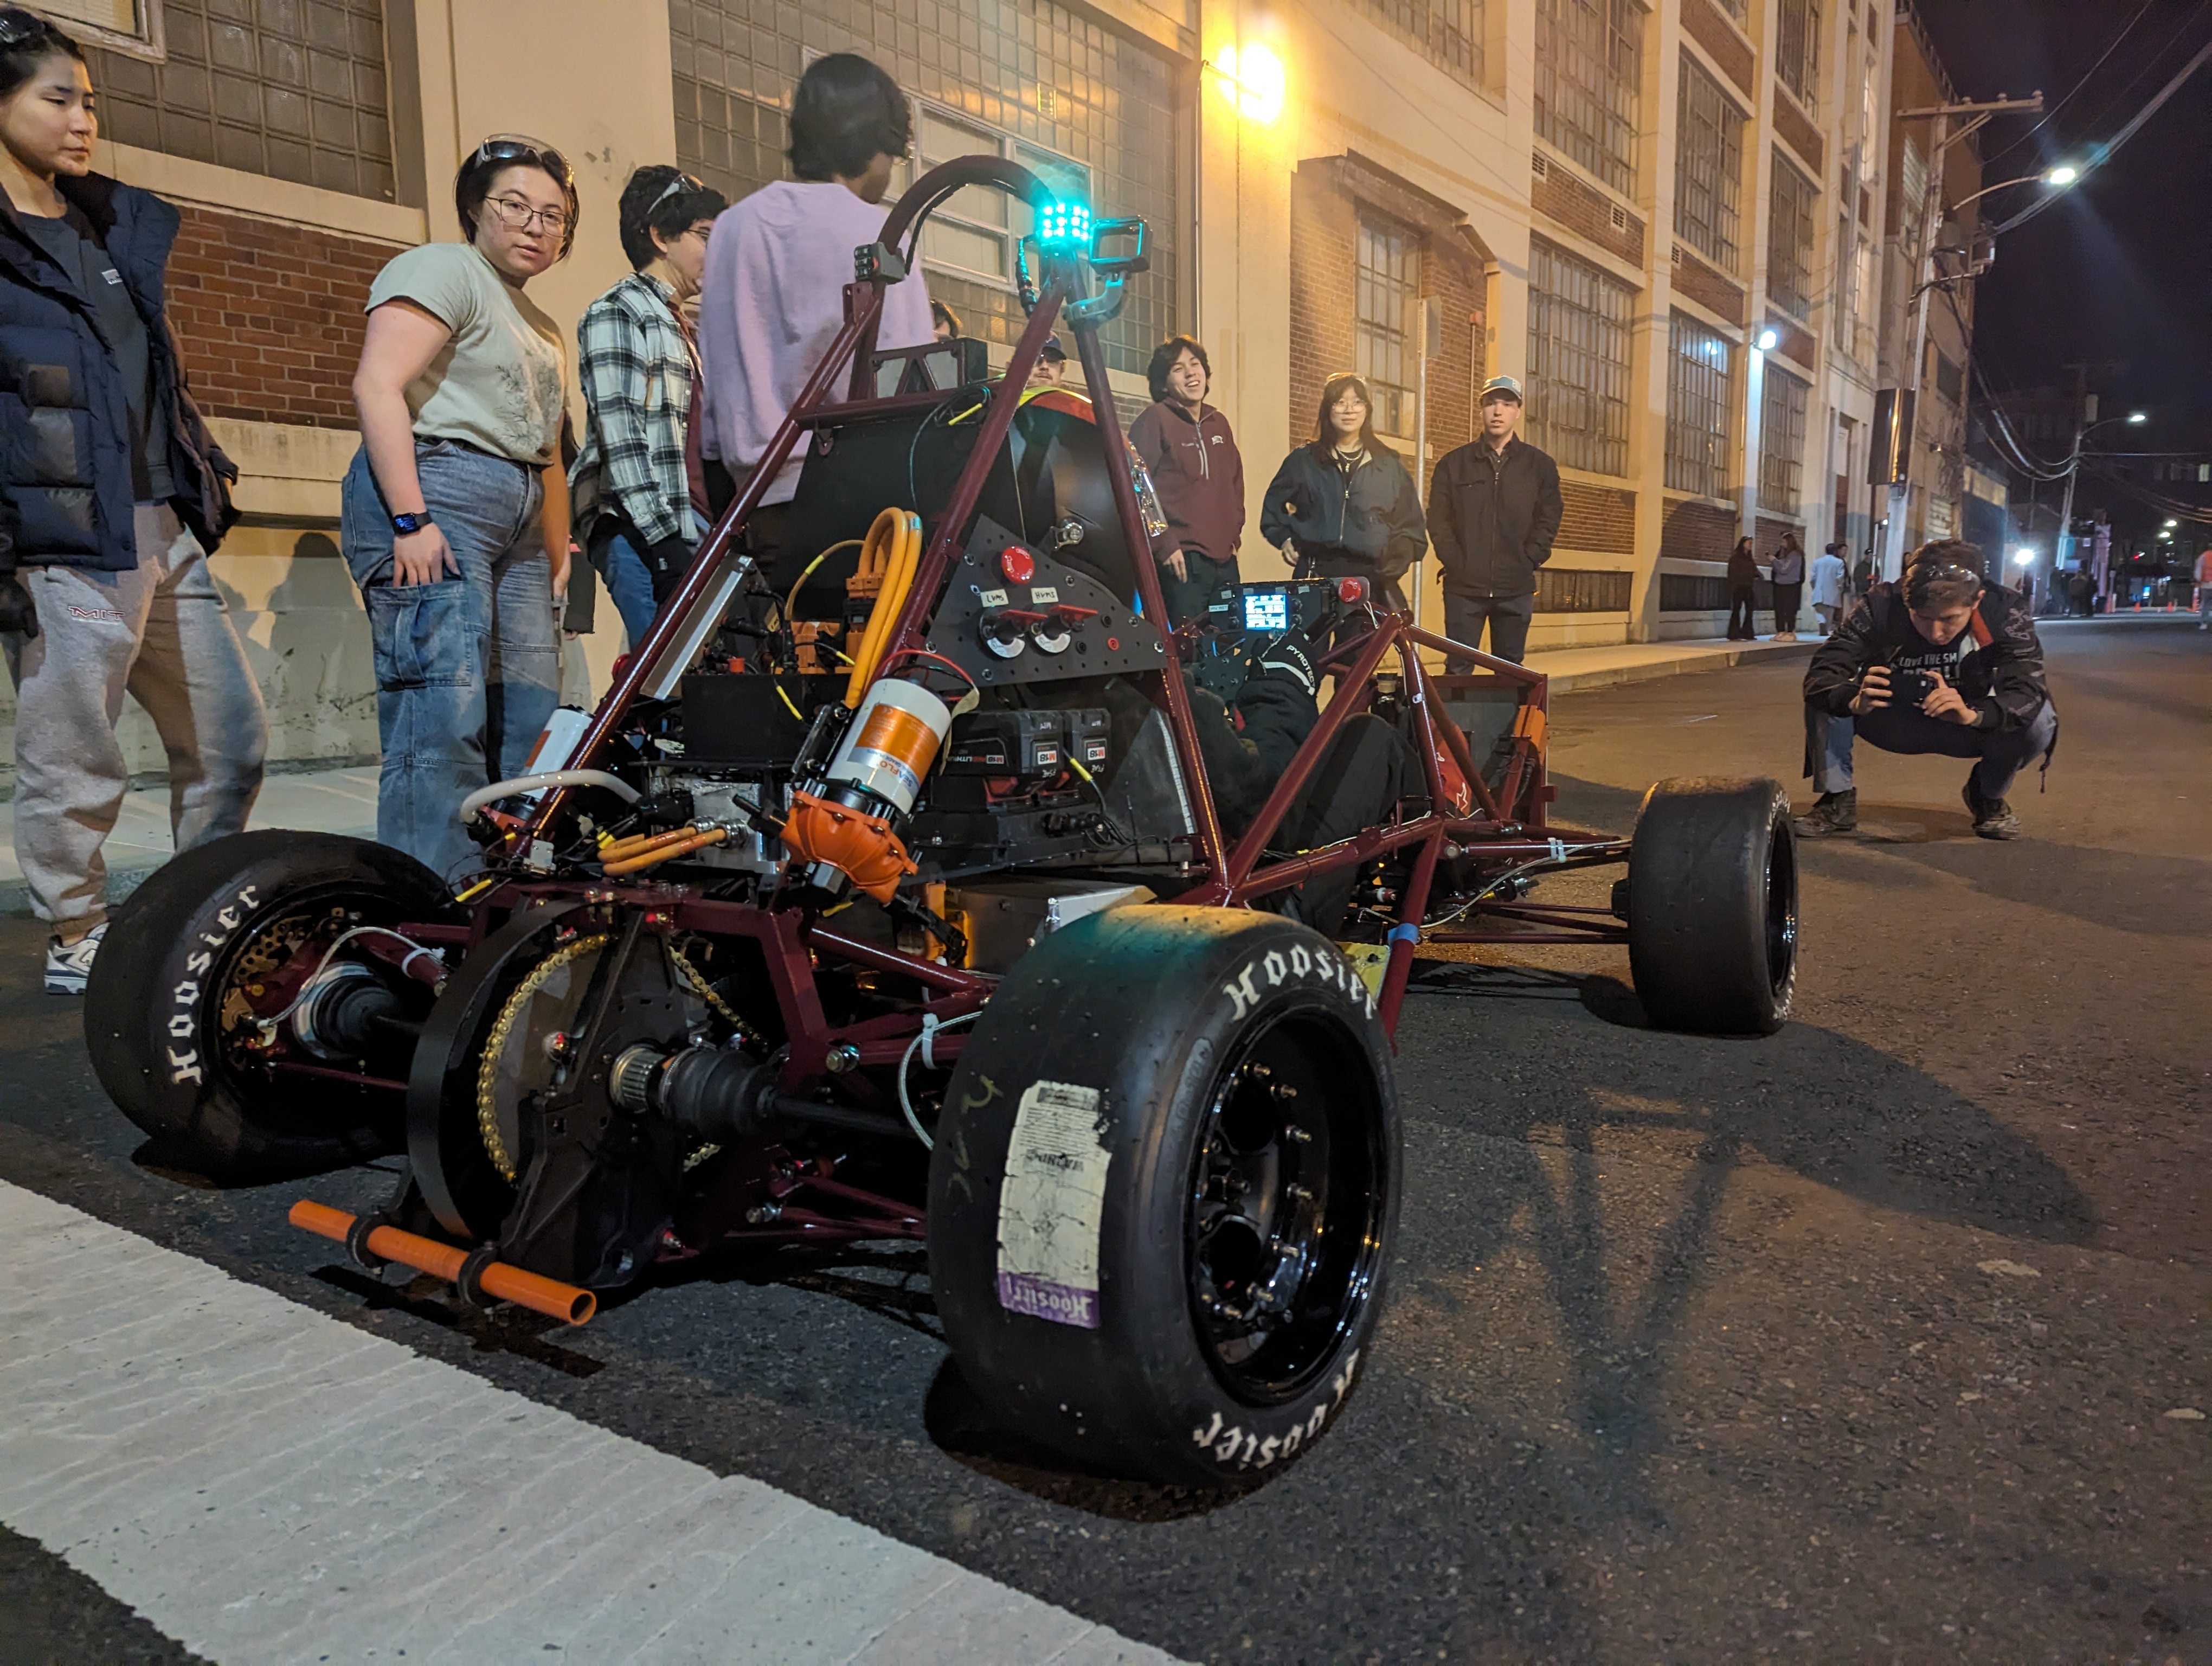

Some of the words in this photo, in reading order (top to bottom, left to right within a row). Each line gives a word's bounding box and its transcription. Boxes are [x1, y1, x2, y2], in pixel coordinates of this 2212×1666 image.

[68, 606, 125, 621] MIT
[1900, 657, 1923, 667] LOVE
[1925, 653, 1941, 665] THE
[1039, 753, 1056, 762] M18
[1089, 748, 1105, 758] M18
[880, 760, 913, 787] SEAFLO
[167, 885, 260, 1085] Hoosier
[1222, 942, 1378, 1022] Hoosier
